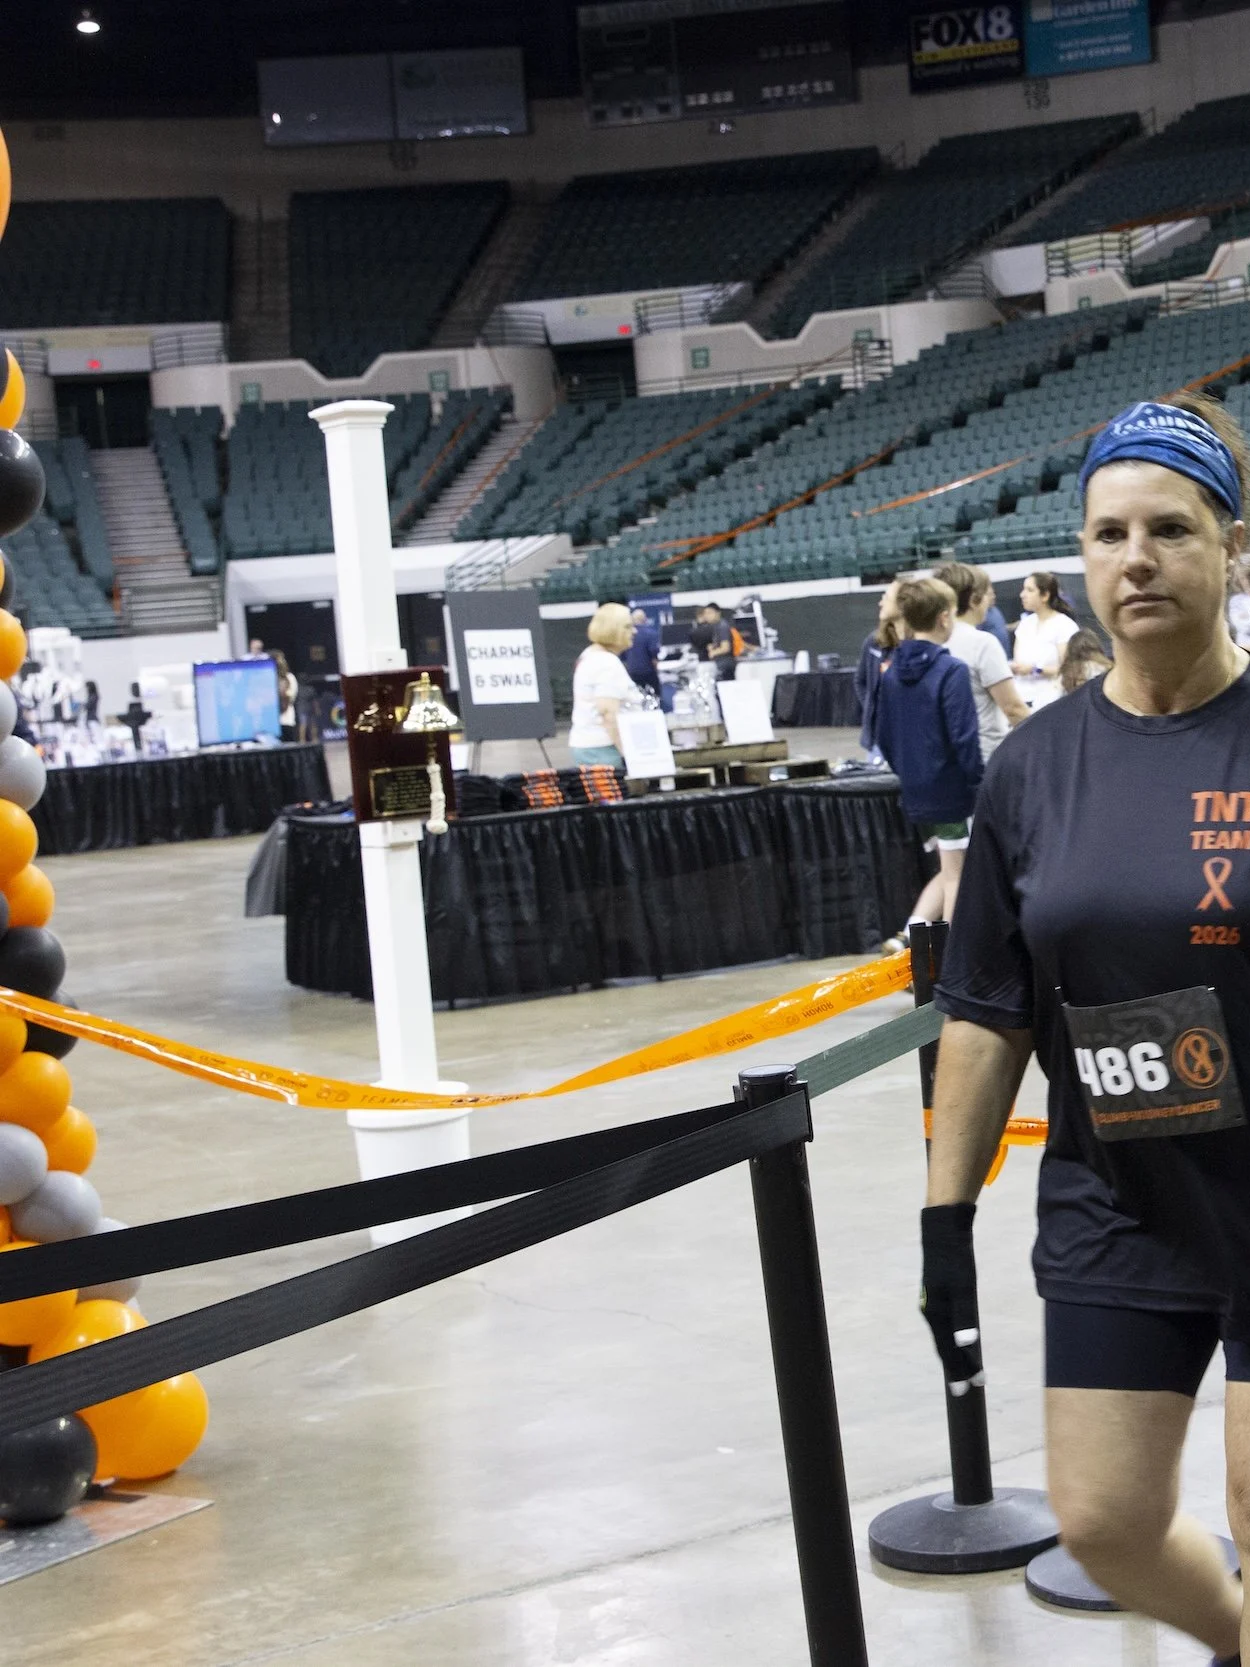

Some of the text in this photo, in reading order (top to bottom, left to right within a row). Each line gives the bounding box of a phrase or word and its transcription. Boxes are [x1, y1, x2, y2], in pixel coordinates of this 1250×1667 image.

[467, 645, 534, 660] CHARMS
[490, 672, 533, 688] SWAG
[1074, 1042, 1171, 1096] 486
